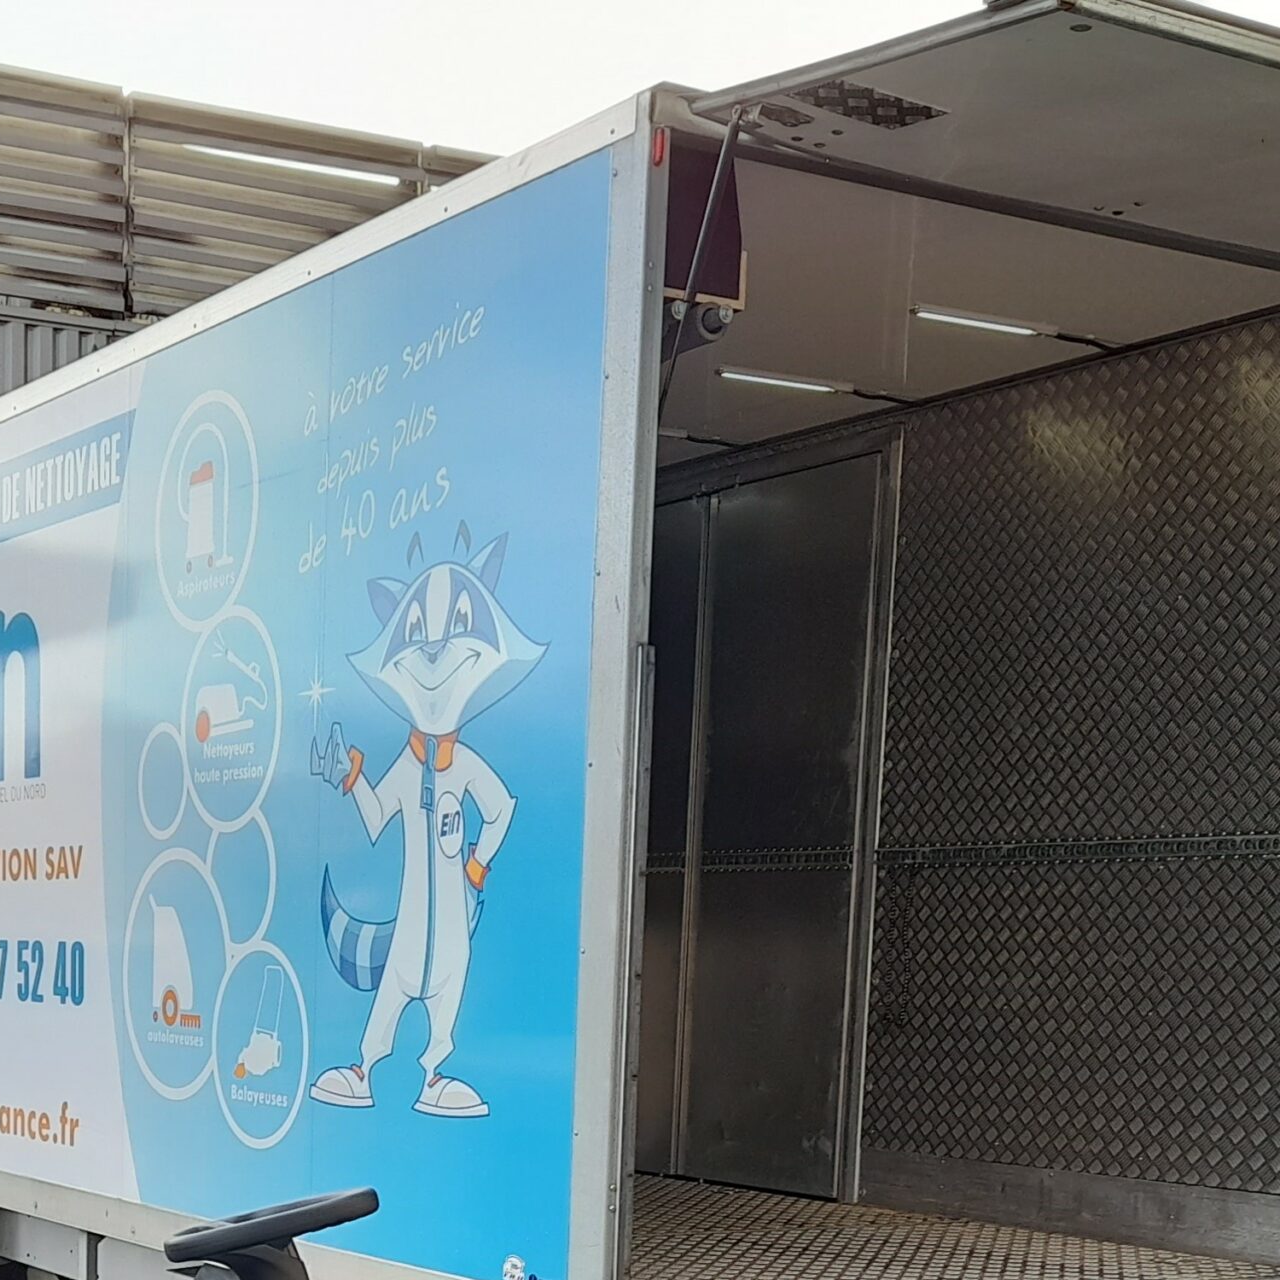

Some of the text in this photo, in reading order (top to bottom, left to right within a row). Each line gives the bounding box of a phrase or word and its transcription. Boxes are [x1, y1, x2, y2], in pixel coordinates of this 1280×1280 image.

[304, 302, 485, 436] à votre service
[2, 472, 21, 524] DE
[25, 432, 122, 515] NETTOYAGE
[317, 401, 437, 498] depuis plus
[298, 466, 450, 573] de 40 ans
[23, 783, 46, 800] NORD
[223, 763, 264, 787] pression
[45, 845, 83, 880] SAV
[17, 940, 44, 1003] 52
[53, 941, 85, 1006] 40
[231, 1084, 289, 1108] Balayeuses
